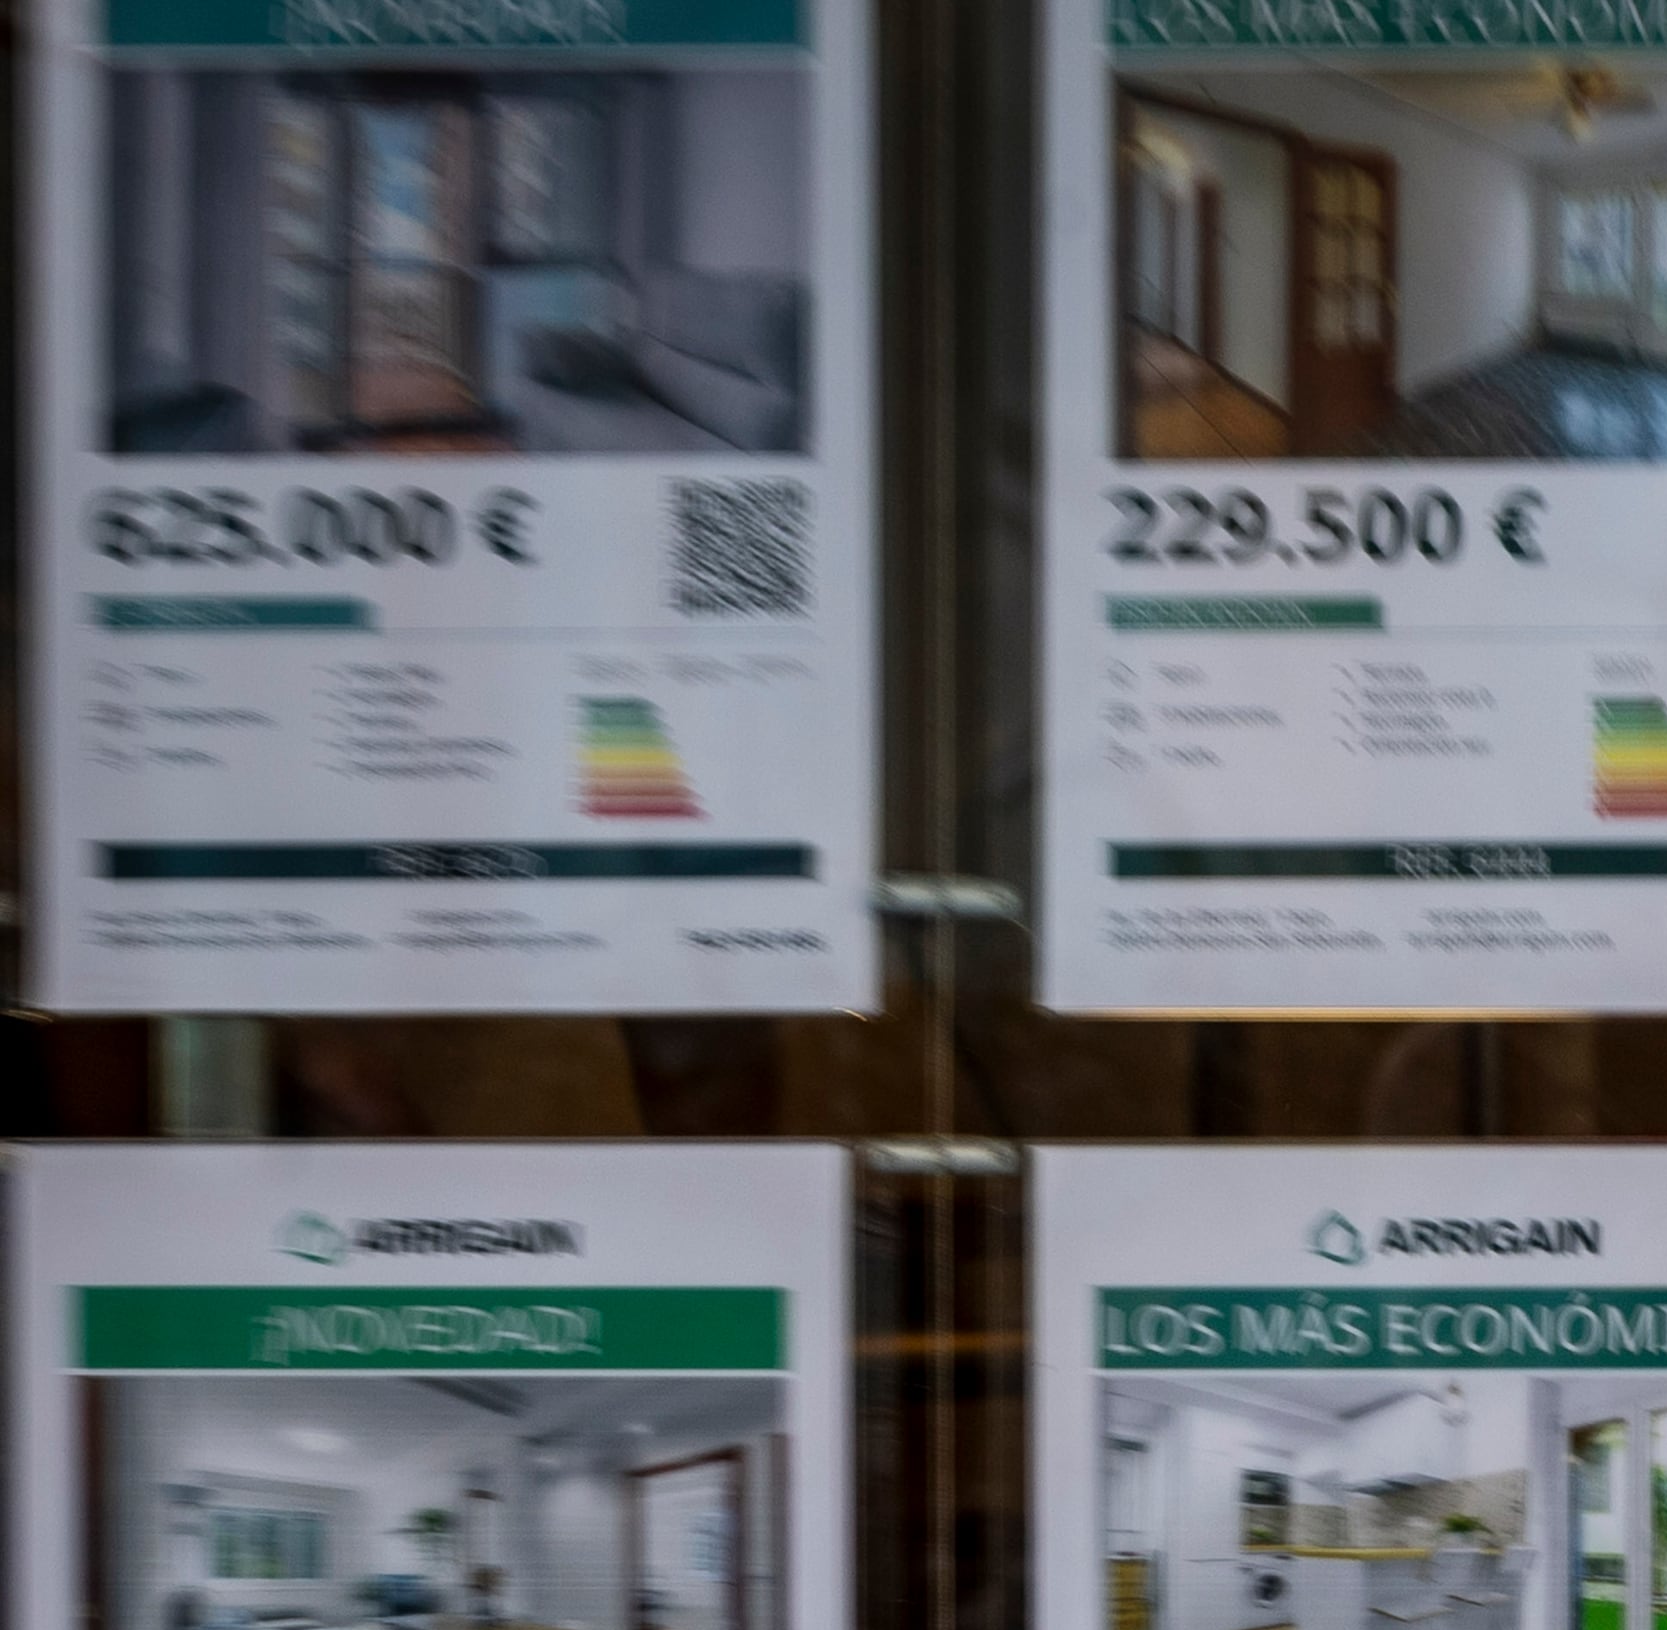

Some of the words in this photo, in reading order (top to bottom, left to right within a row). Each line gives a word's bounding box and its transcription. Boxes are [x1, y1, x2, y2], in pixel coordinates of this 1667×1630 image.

[1104, 485, 1467, 567] 229.500
[1491, 485, 1549, 567] €
[1378, 1217, 1602, 1256] ARRIGAIN
[1103, 1303, 1226, 1356] LOS
[1232, 1291, 1373, 1356] MÁS
